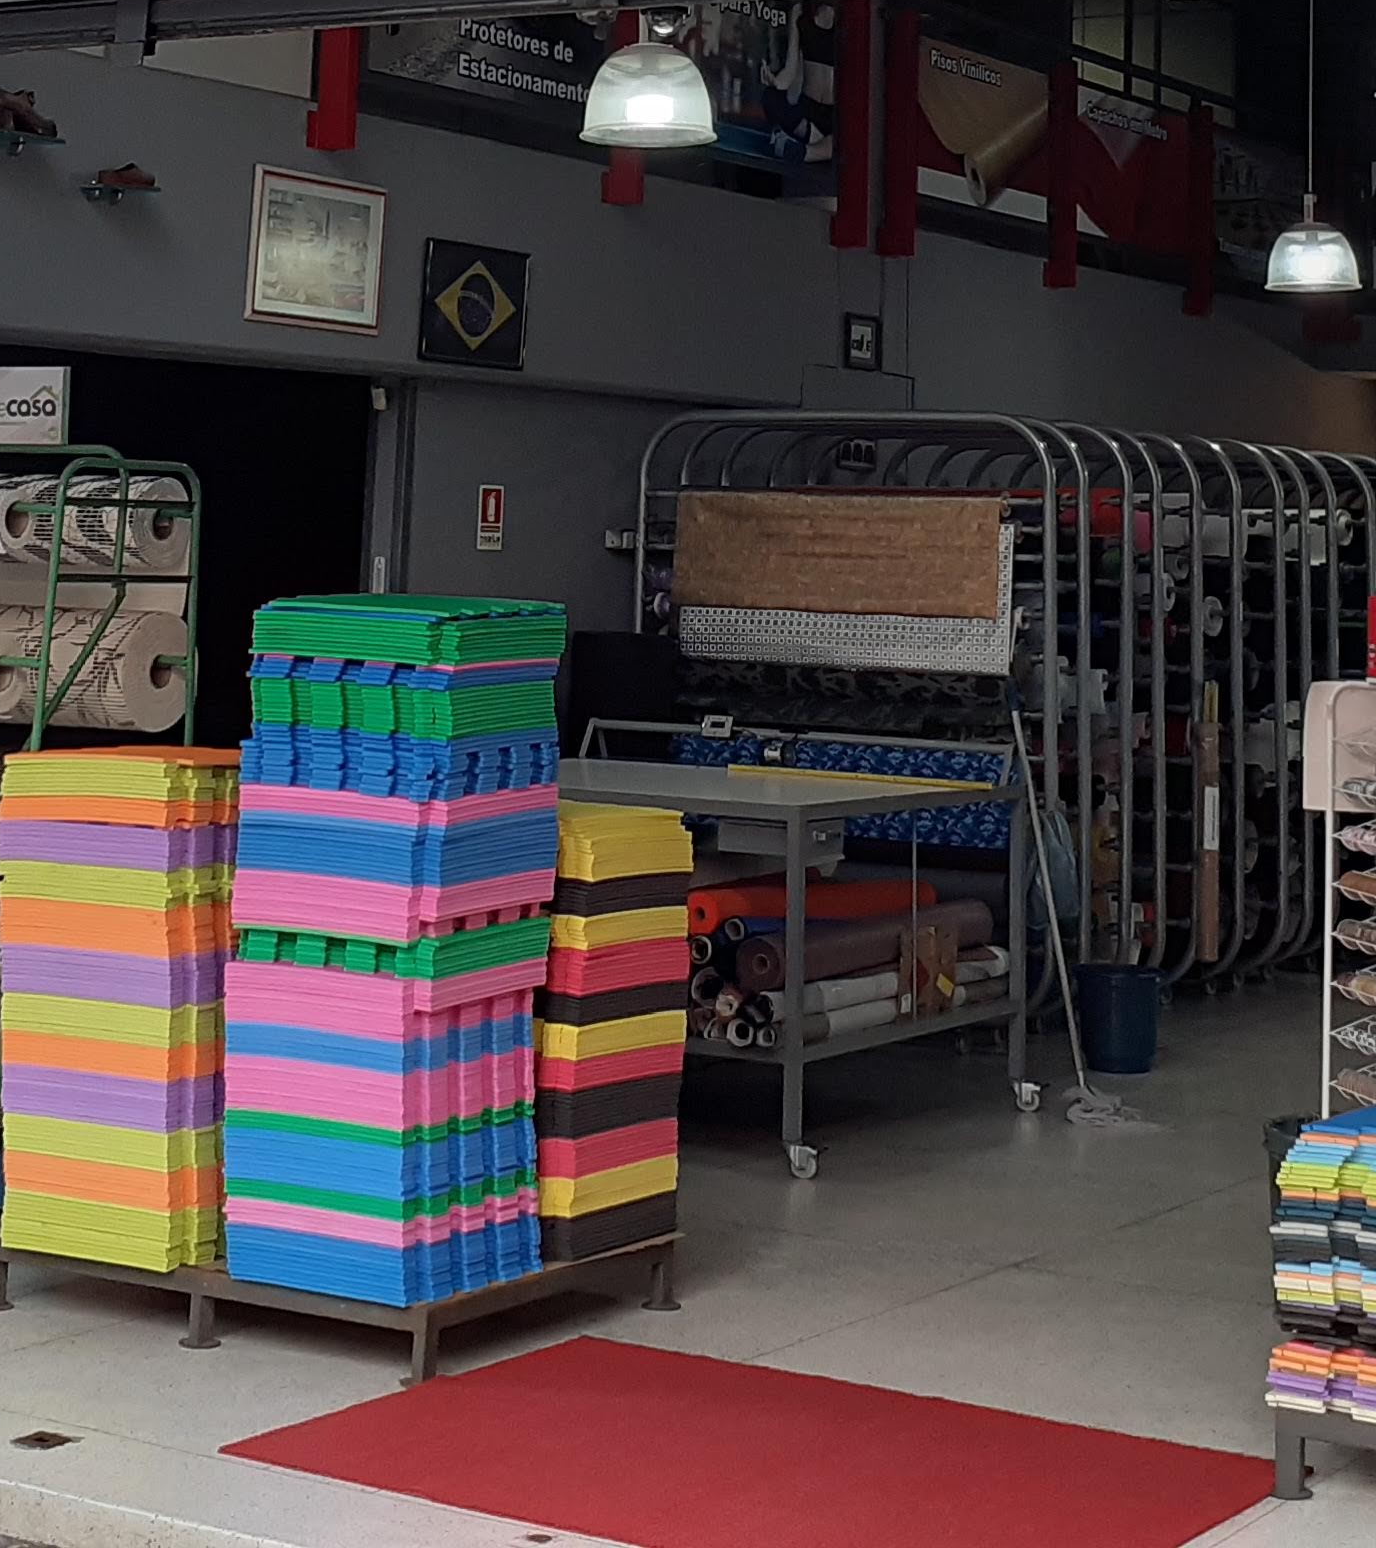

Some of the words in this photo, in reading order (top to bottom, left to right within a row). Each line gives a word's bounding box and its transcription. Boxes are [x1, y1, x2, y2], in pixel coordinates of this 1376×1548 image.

[754, 0, 788, 27] Yoga
[459, 18, 550, 58] Protetores
[552, 40, 575, 64] de
[929, 49, 958, 72] Pisos
